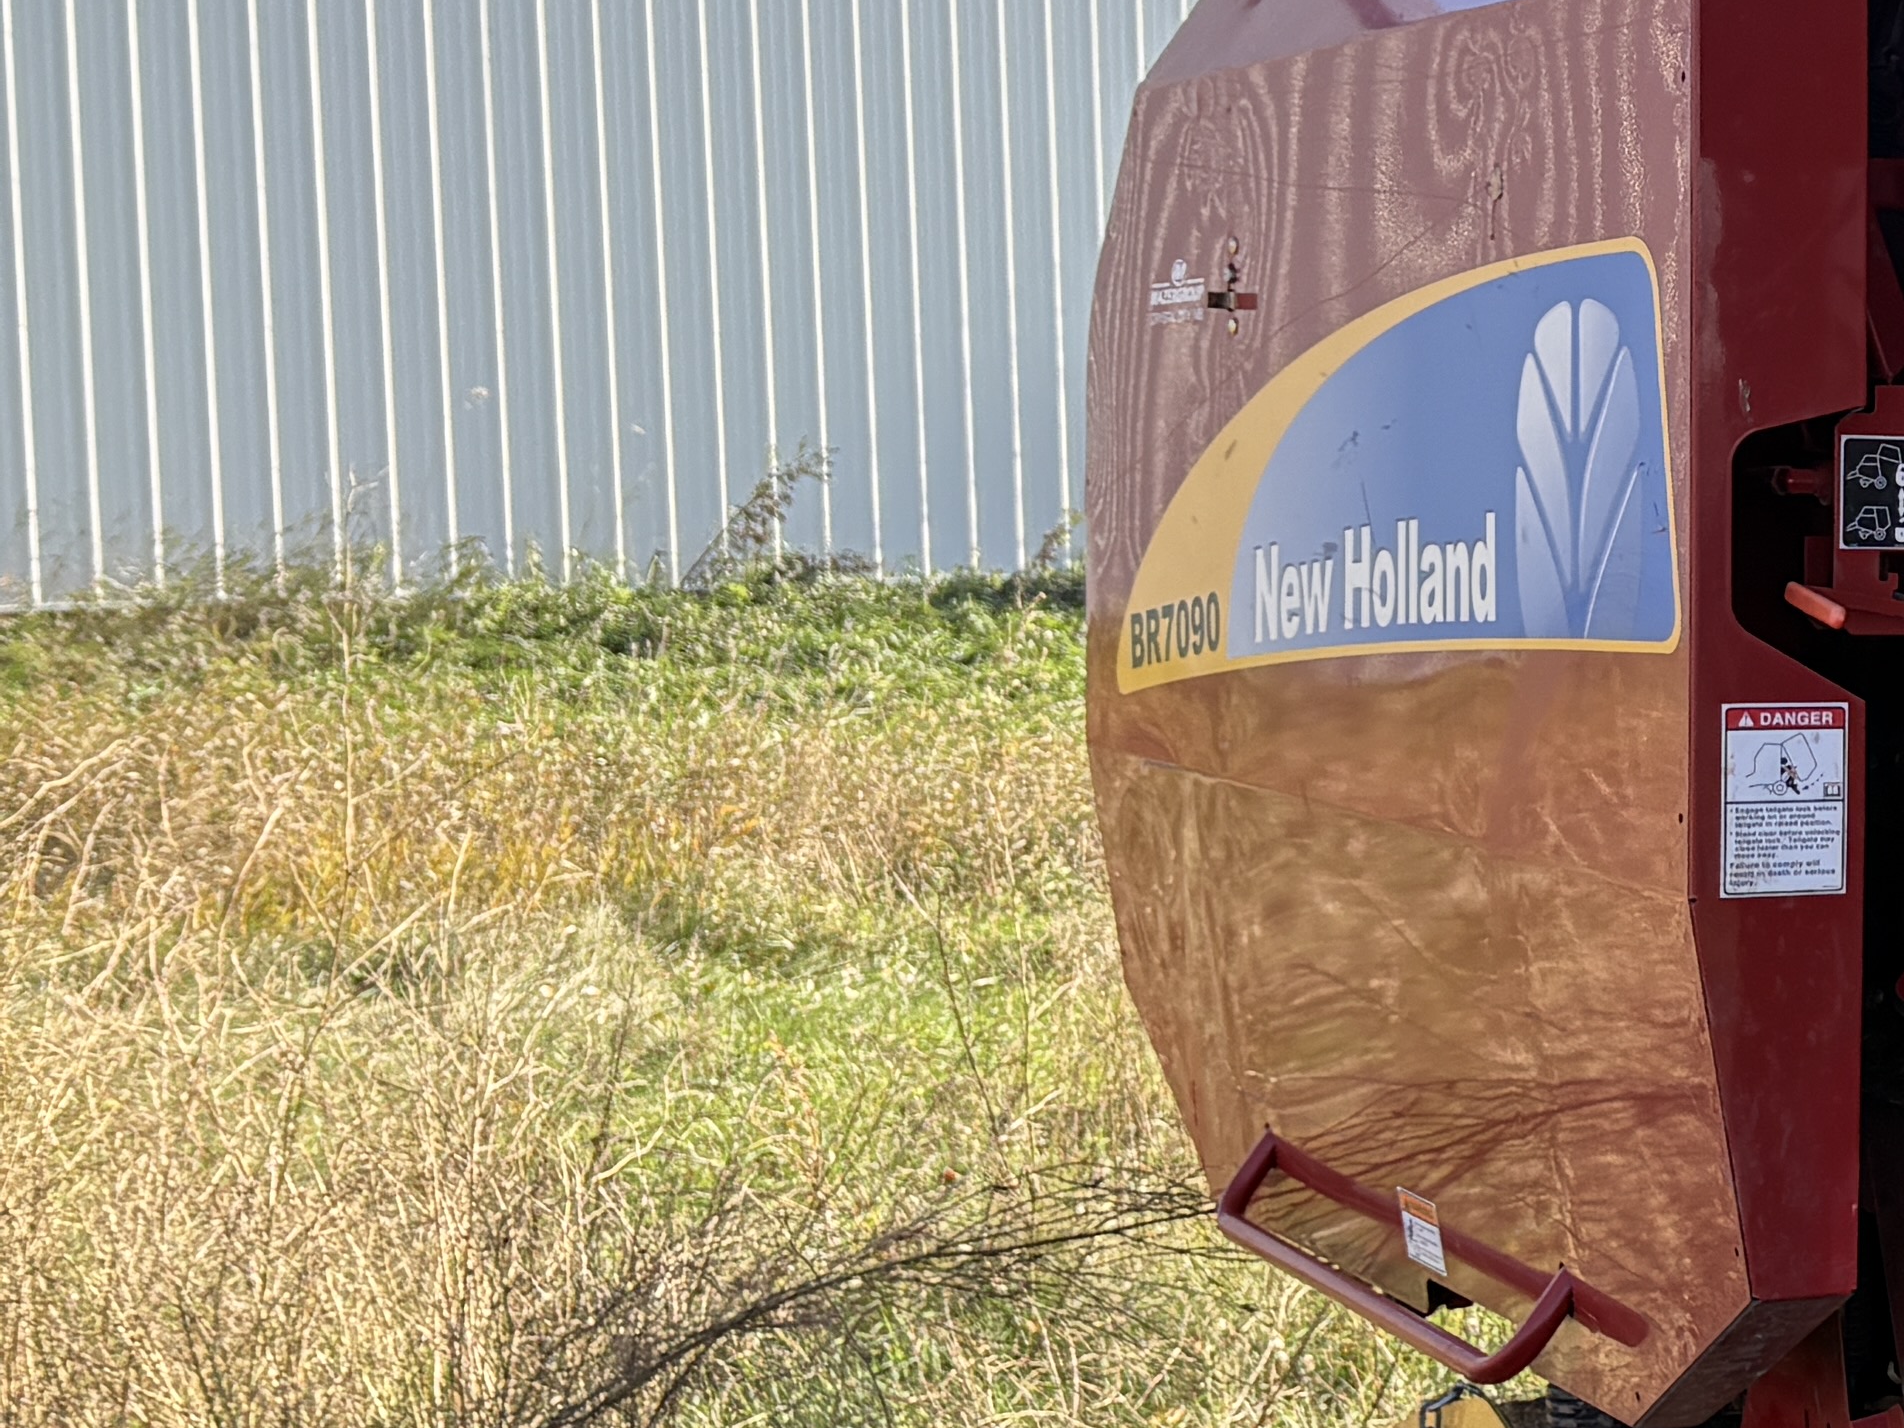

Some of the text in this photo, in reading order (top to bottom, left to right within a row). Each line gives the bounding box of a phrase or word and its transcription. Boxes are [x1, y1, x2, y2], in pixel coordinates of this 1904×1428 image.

[1253, 510, 1496, 643] New Holland
[1131, 591, 1221, 670] BR7090
[1760, 712, 1833, 726] DANGER
